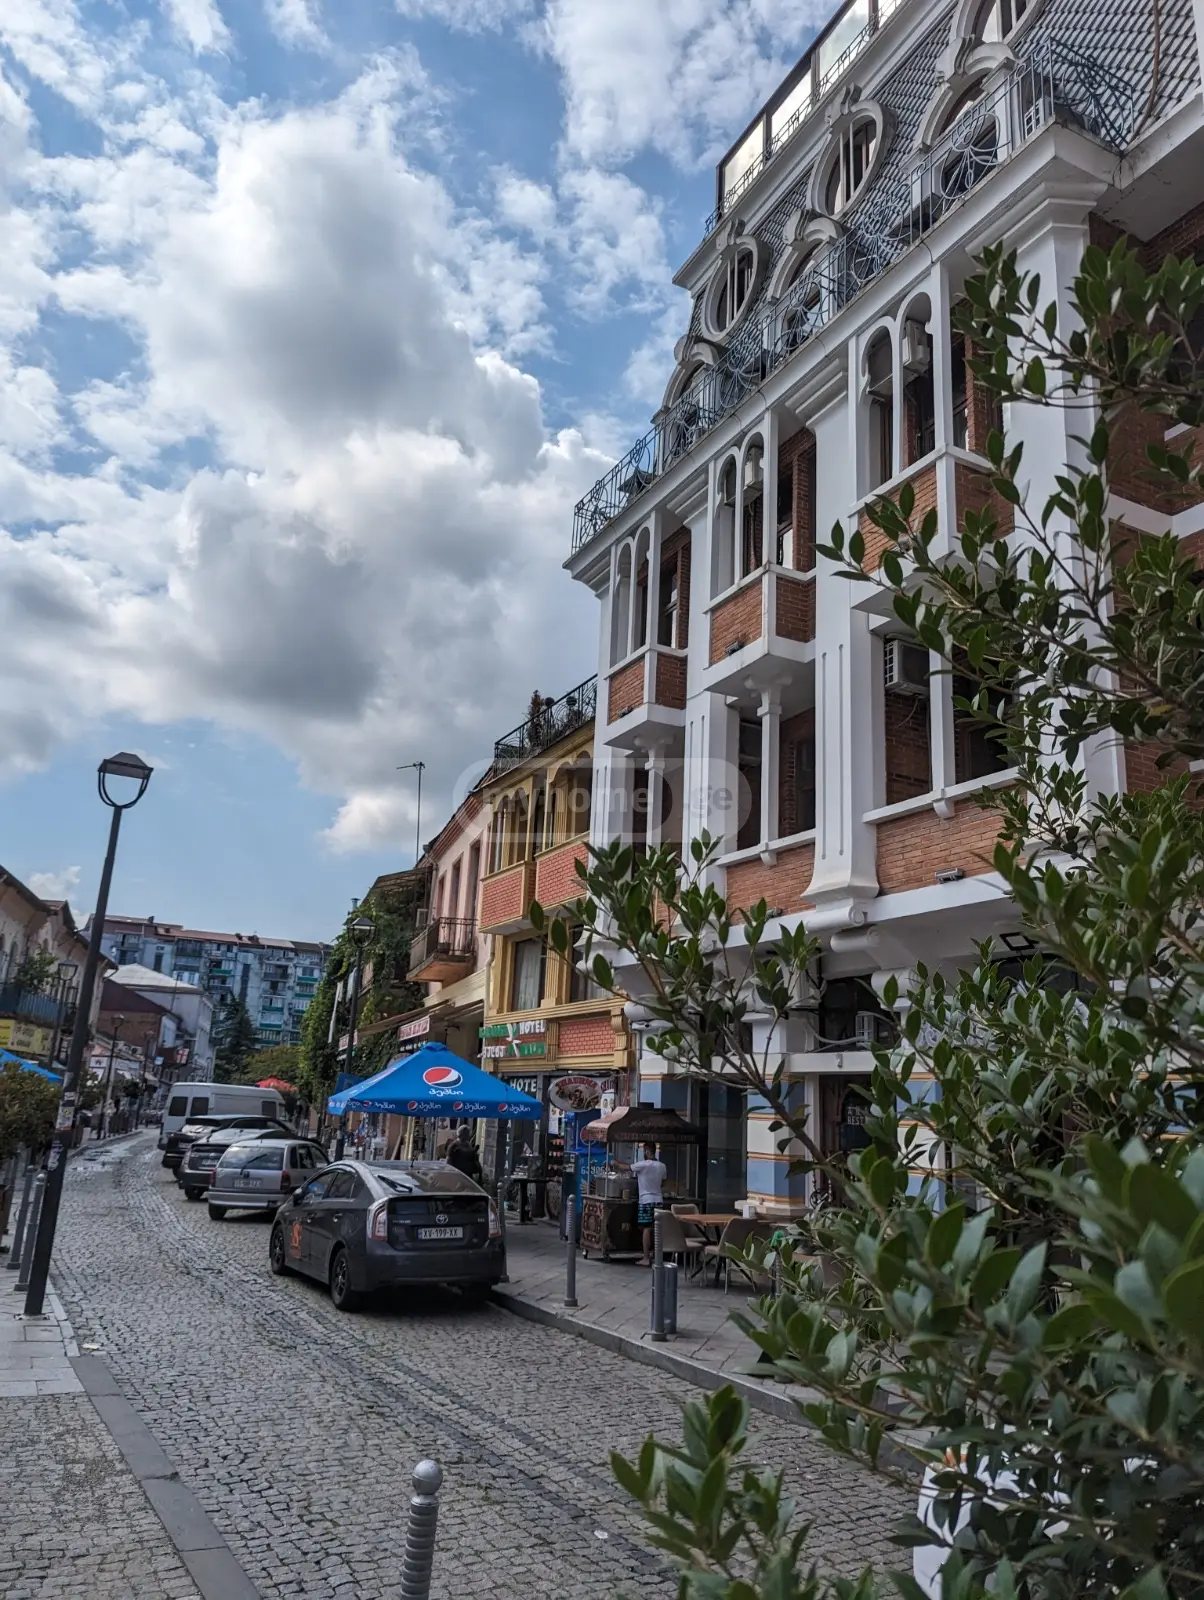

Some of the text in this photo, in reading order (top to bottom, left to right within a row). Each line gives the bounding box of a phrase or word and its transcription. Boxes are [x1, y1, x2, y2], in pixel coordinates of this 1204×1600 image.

[520, 1020, 545, 1034] HOTEL
[429, 1088, 464, 1097] პეპსი
[509, 1078, 537, 1093] HOTE
